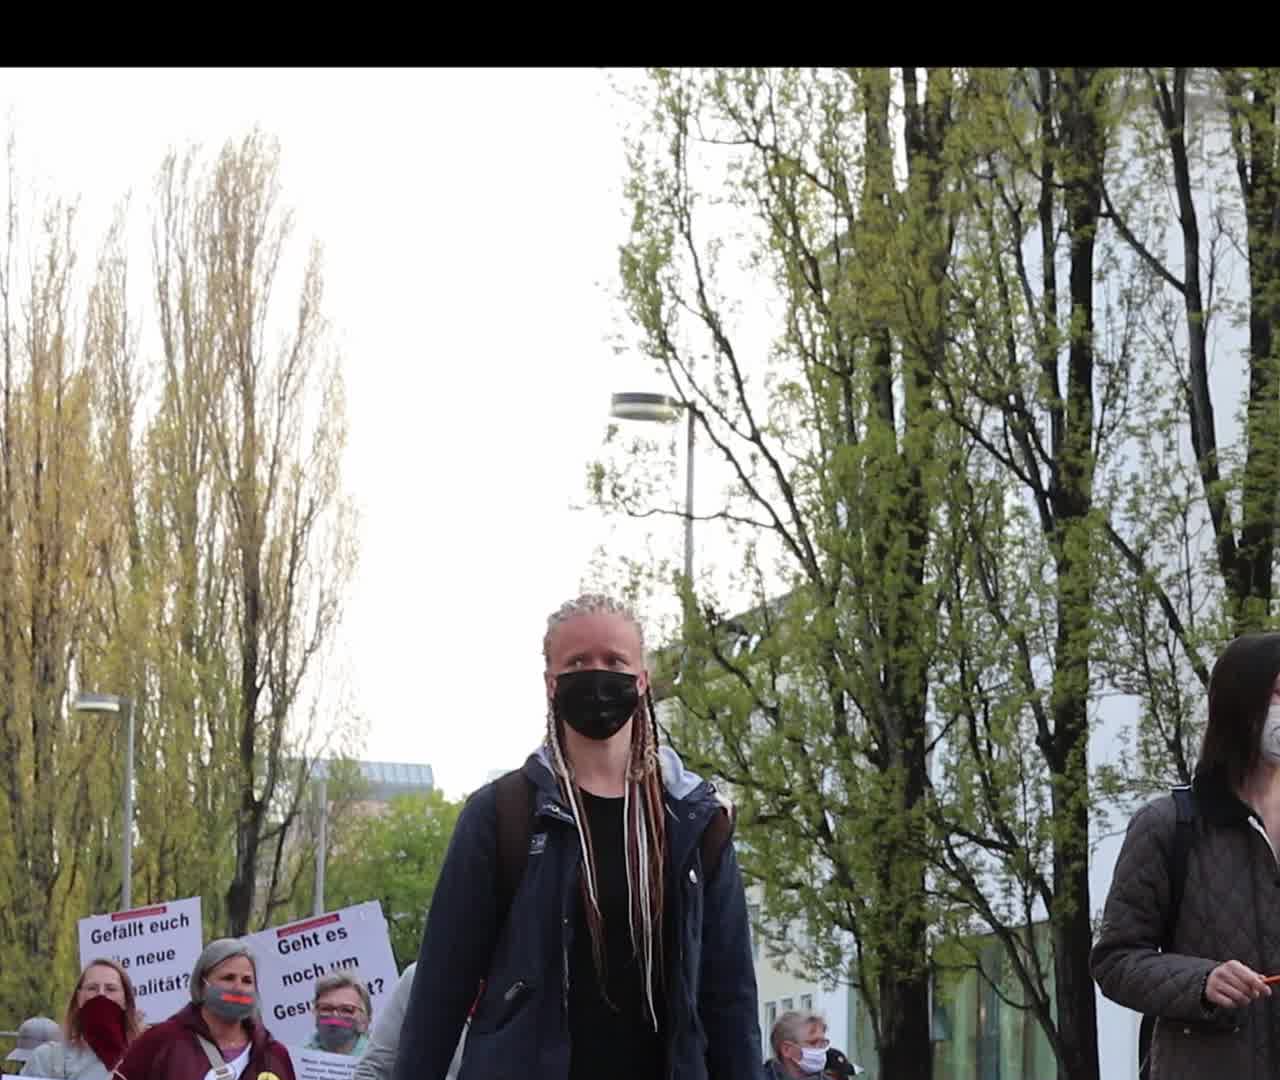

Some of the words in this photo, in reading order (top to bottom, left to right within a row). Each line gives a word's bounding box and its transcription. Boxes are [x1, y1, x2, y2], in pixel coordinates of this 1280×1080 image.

[91, 921, 144, 944] Gefällt
[150, 912, 190, 933] euch
[277, 931, 321, 955] Geht
[325, 926, 348, 942] es
[136, 949, 176, 966] neue
[281, 963, 325, 987] noch
